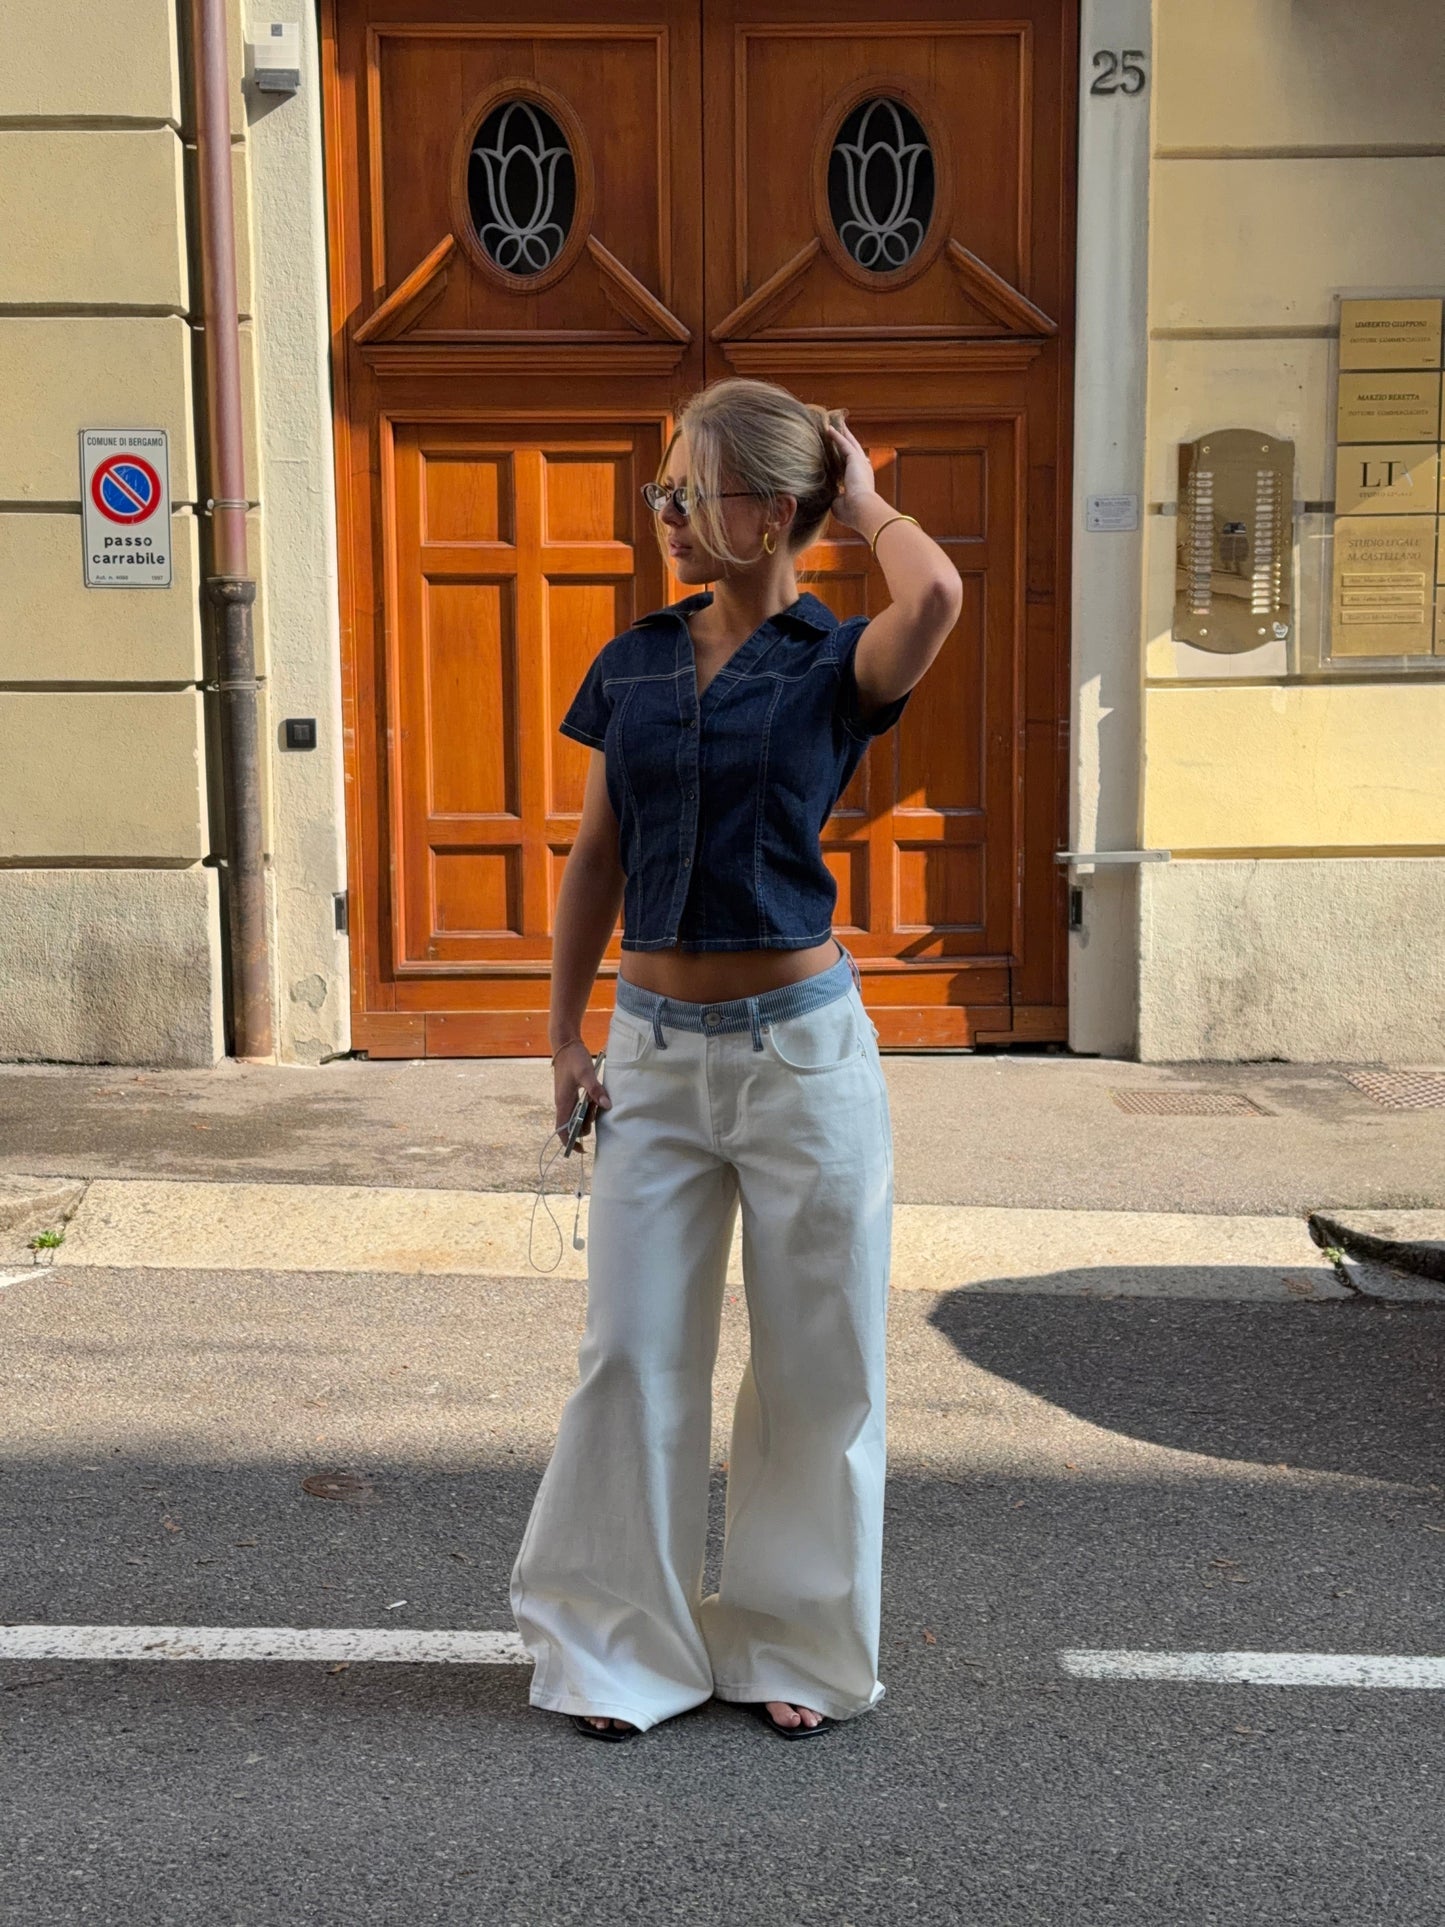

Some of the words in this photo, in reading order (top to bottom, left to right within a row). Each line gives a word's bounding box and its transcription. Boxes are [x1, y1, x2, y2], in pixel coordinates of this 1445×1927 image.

[1090, 50, 1145, 95] 25
[1388, 393, 1420, 401] BERETTA
[86, 437, 117, 446] COMUNE
[119, 437, 127, 446] DI
[128, 437, 164, 447] BERGAMO
[104, 536, 153, 549] passo
[1348, 539, 1384, 548] STUDIO
[1386, 538, 1420, 547] LEGALE
[92, 552, 166, 565] carrabile
[1360, 552, 1422, 561] CASTELLANO
